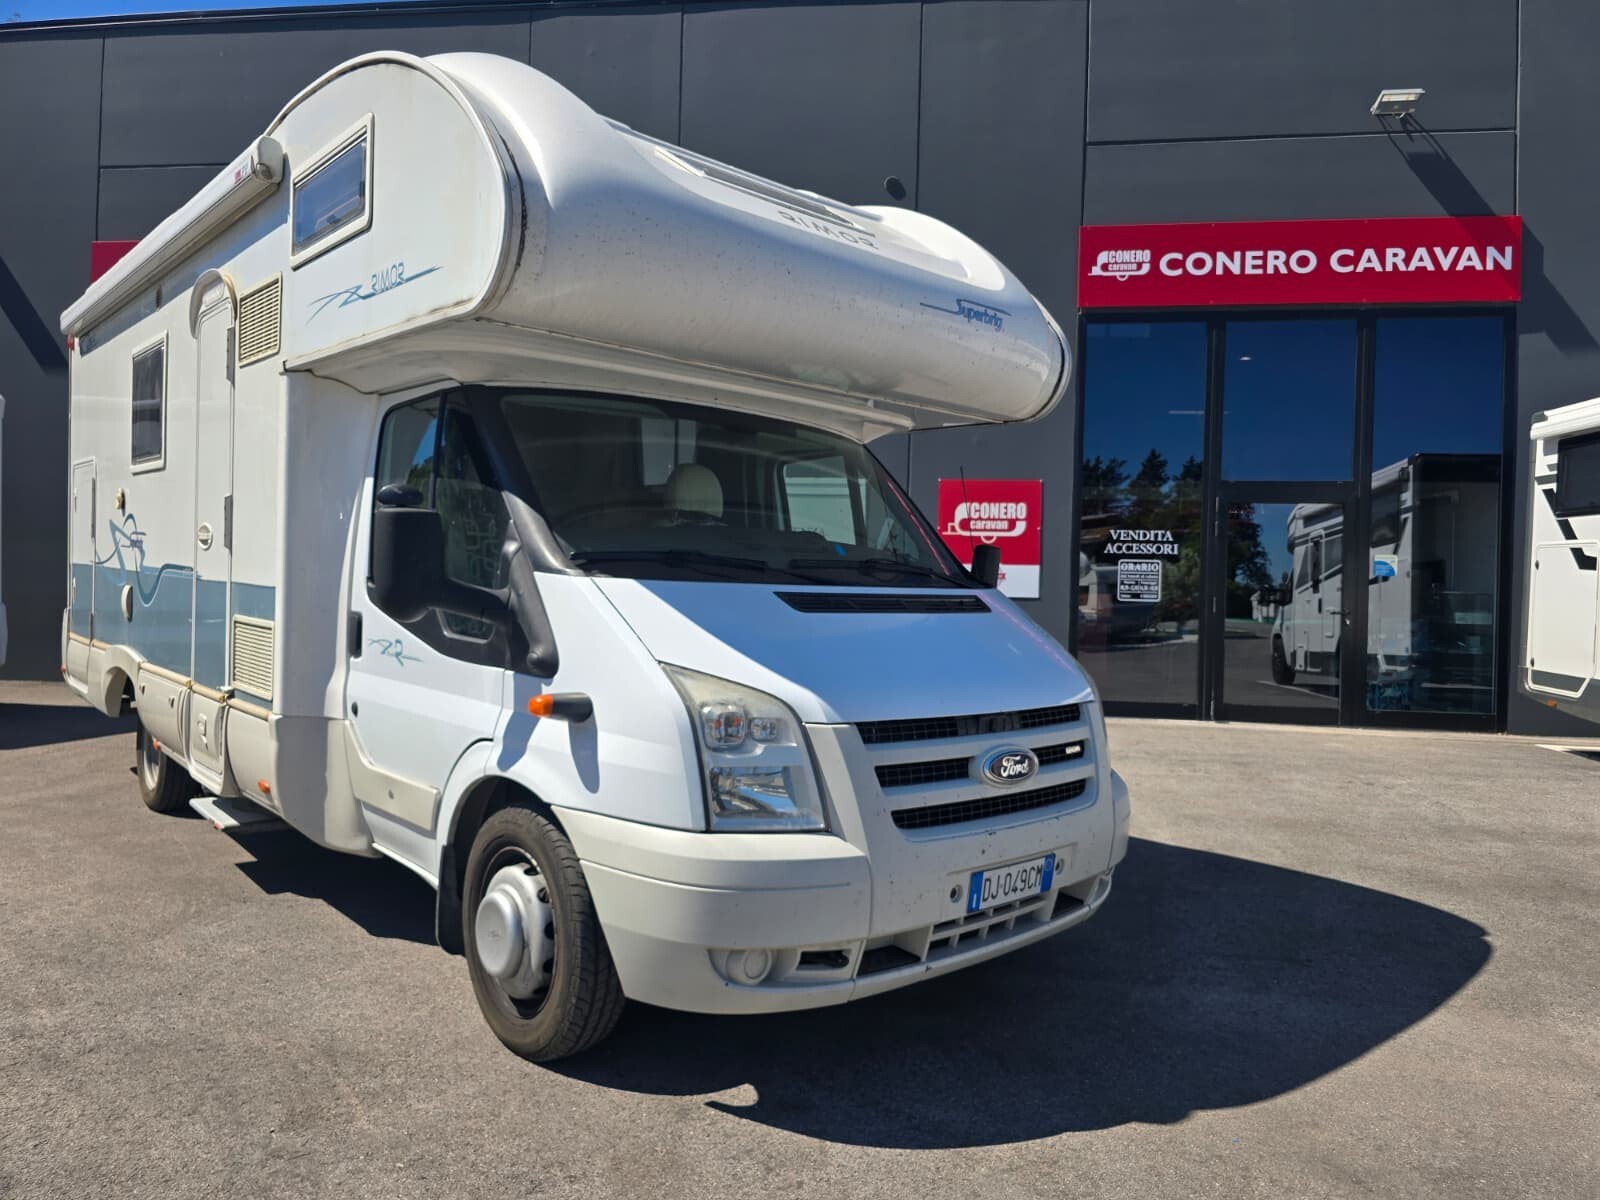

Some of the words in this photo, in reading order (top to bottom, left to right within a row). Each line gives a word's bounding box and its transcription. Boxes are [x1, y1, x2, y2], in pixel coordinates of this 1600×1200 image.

[1108, 249, 1151, 263] CONERO
[1159, 250, 1317, 276] CONERO
[1329, 246, 1514, 273] CARAVAN
[371, 261, 405, 293] RIMOR
[956, 299, 1004, 332] Superbrig
[970, 502, 1027, 520] CONERO
[970, 520, 1009, 530] caravan
[1109, 529, 1174, 541] VENDITA
[1103, 542, 1179, 555] ACCESSORI
[1120, 562, 1159, 571] ORARIO
[1000, 756, 1029, 777] Ford
